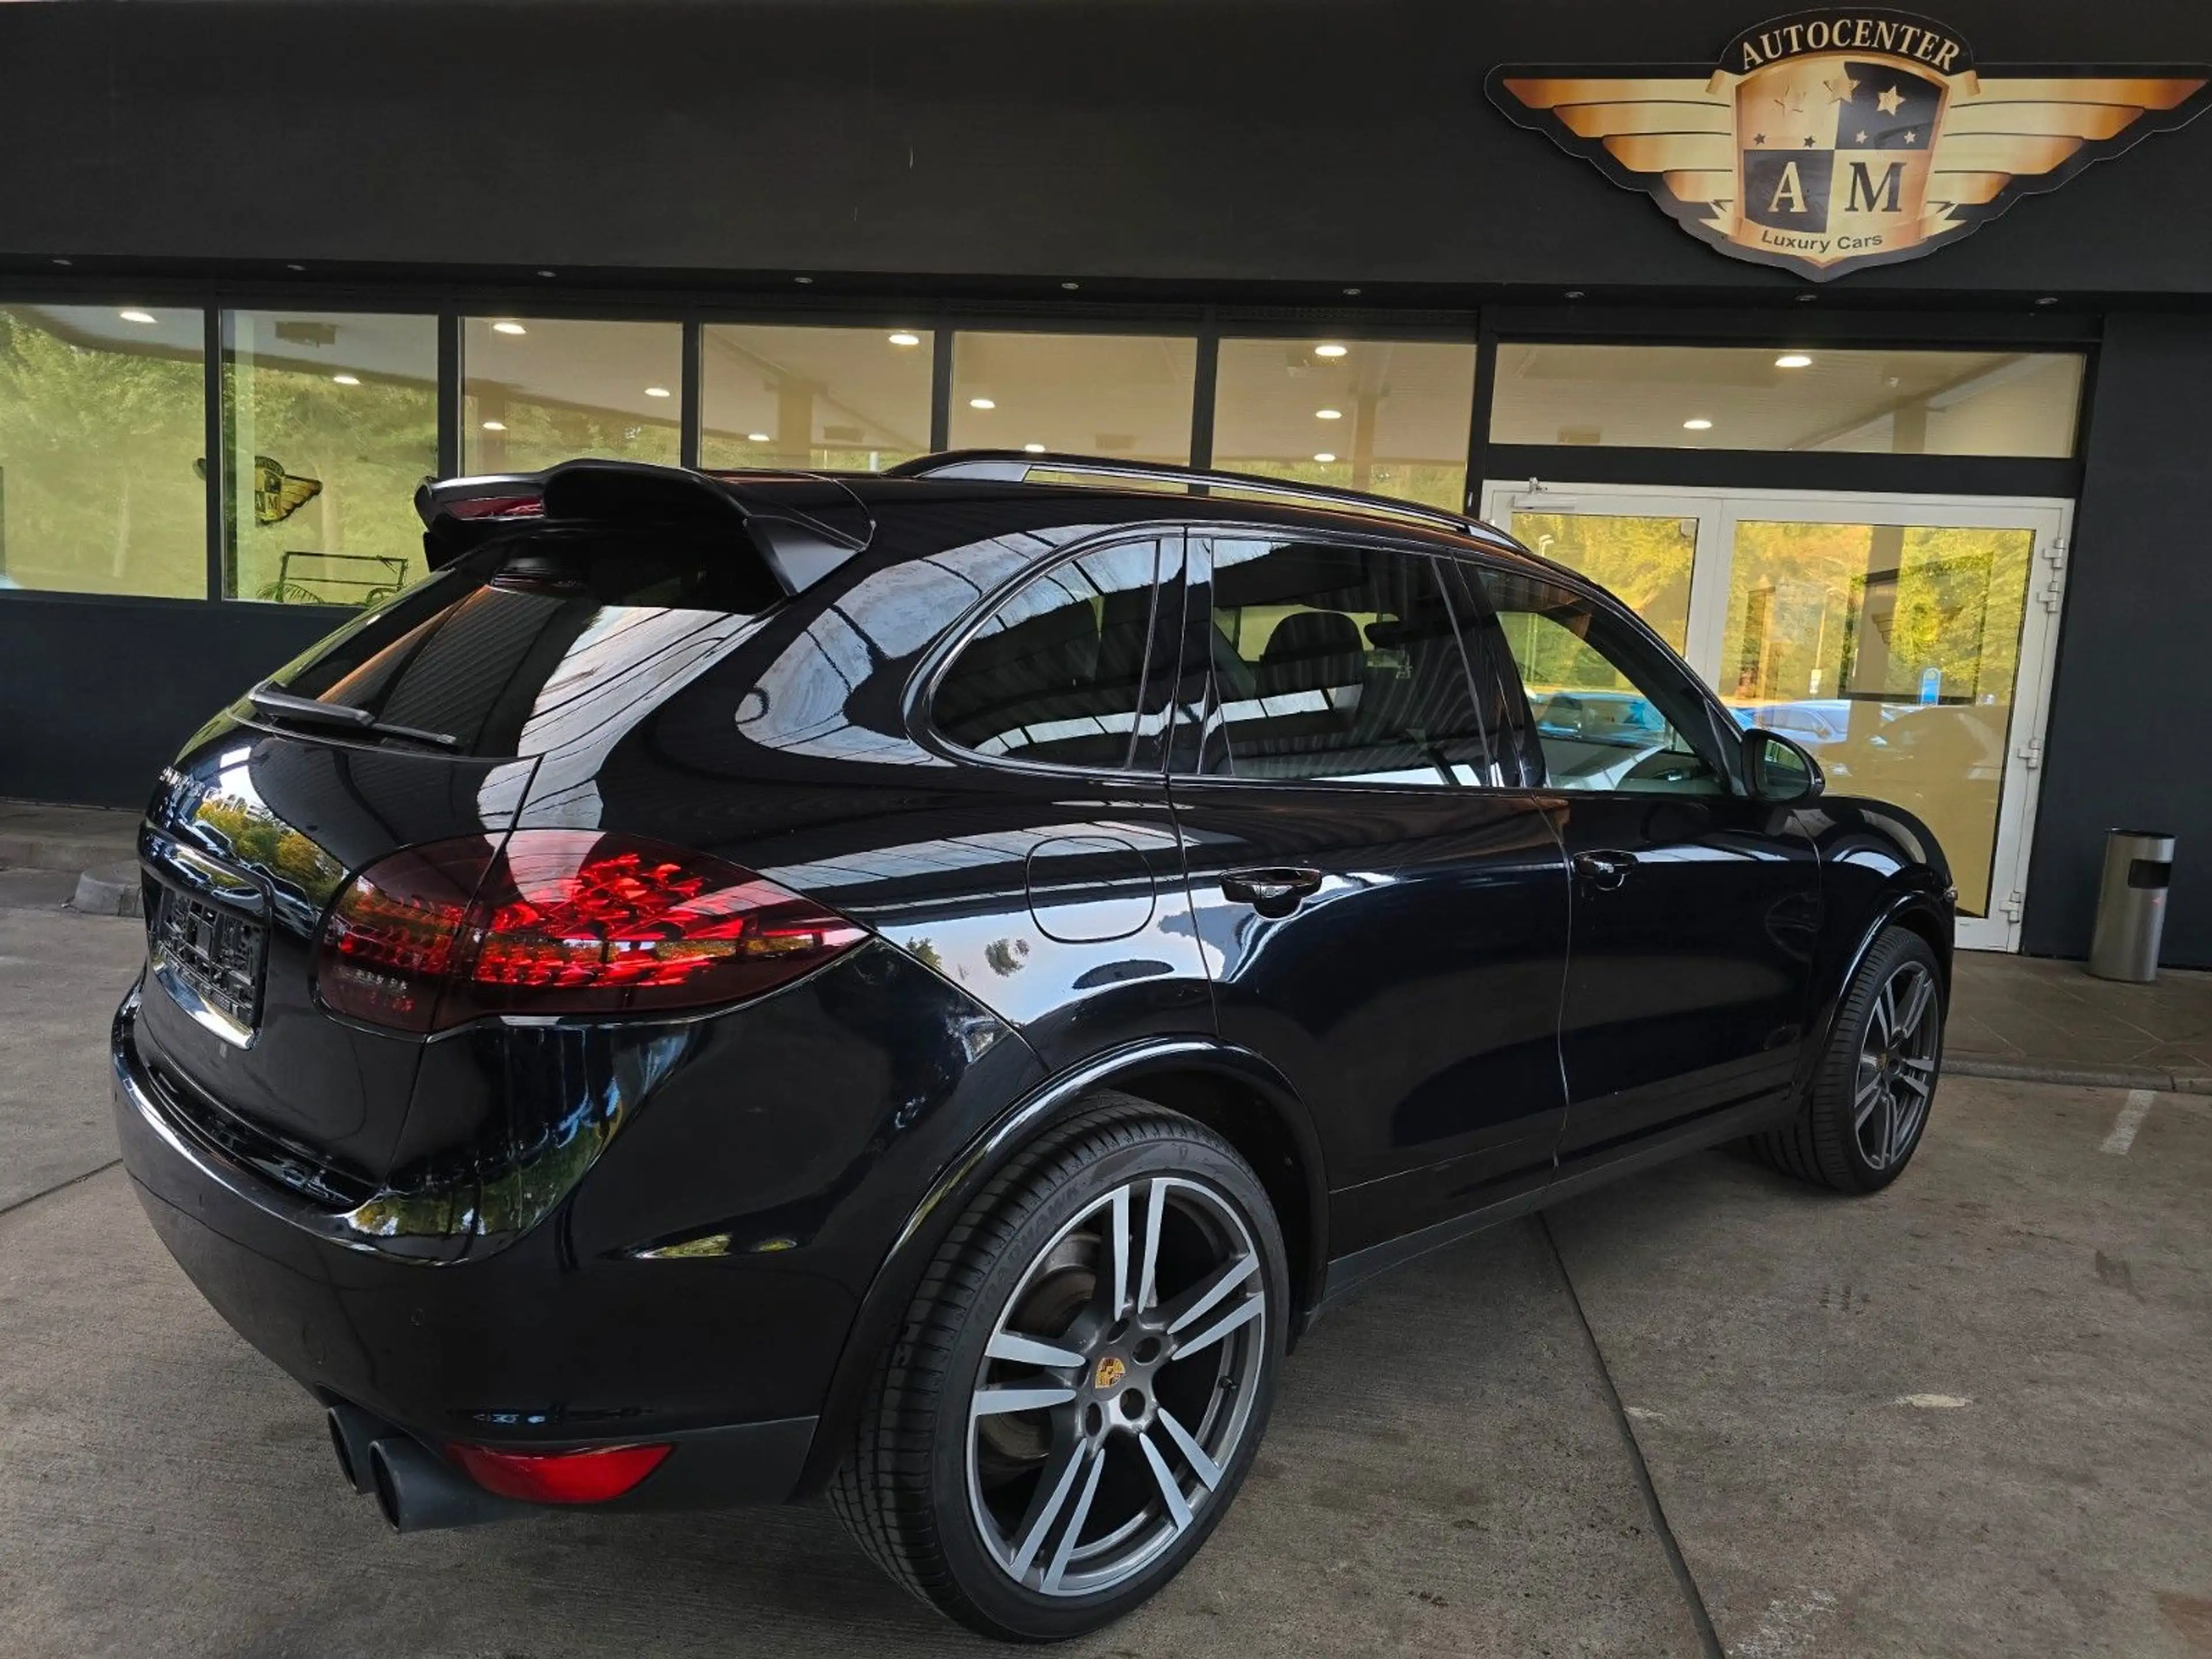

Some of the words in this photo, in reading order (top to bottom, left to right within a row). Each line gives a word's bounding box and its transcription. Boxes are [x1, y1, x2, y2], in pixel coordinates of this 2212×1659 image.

[1743, 19, 1960, 71] AUTOCENTER
[1768, 161, 1808, 213] A
[1844, 161, 1907, 213] M
[1761, 230, 1831, 253] Luxury
[1837, 234, 1883, 250] Cars
